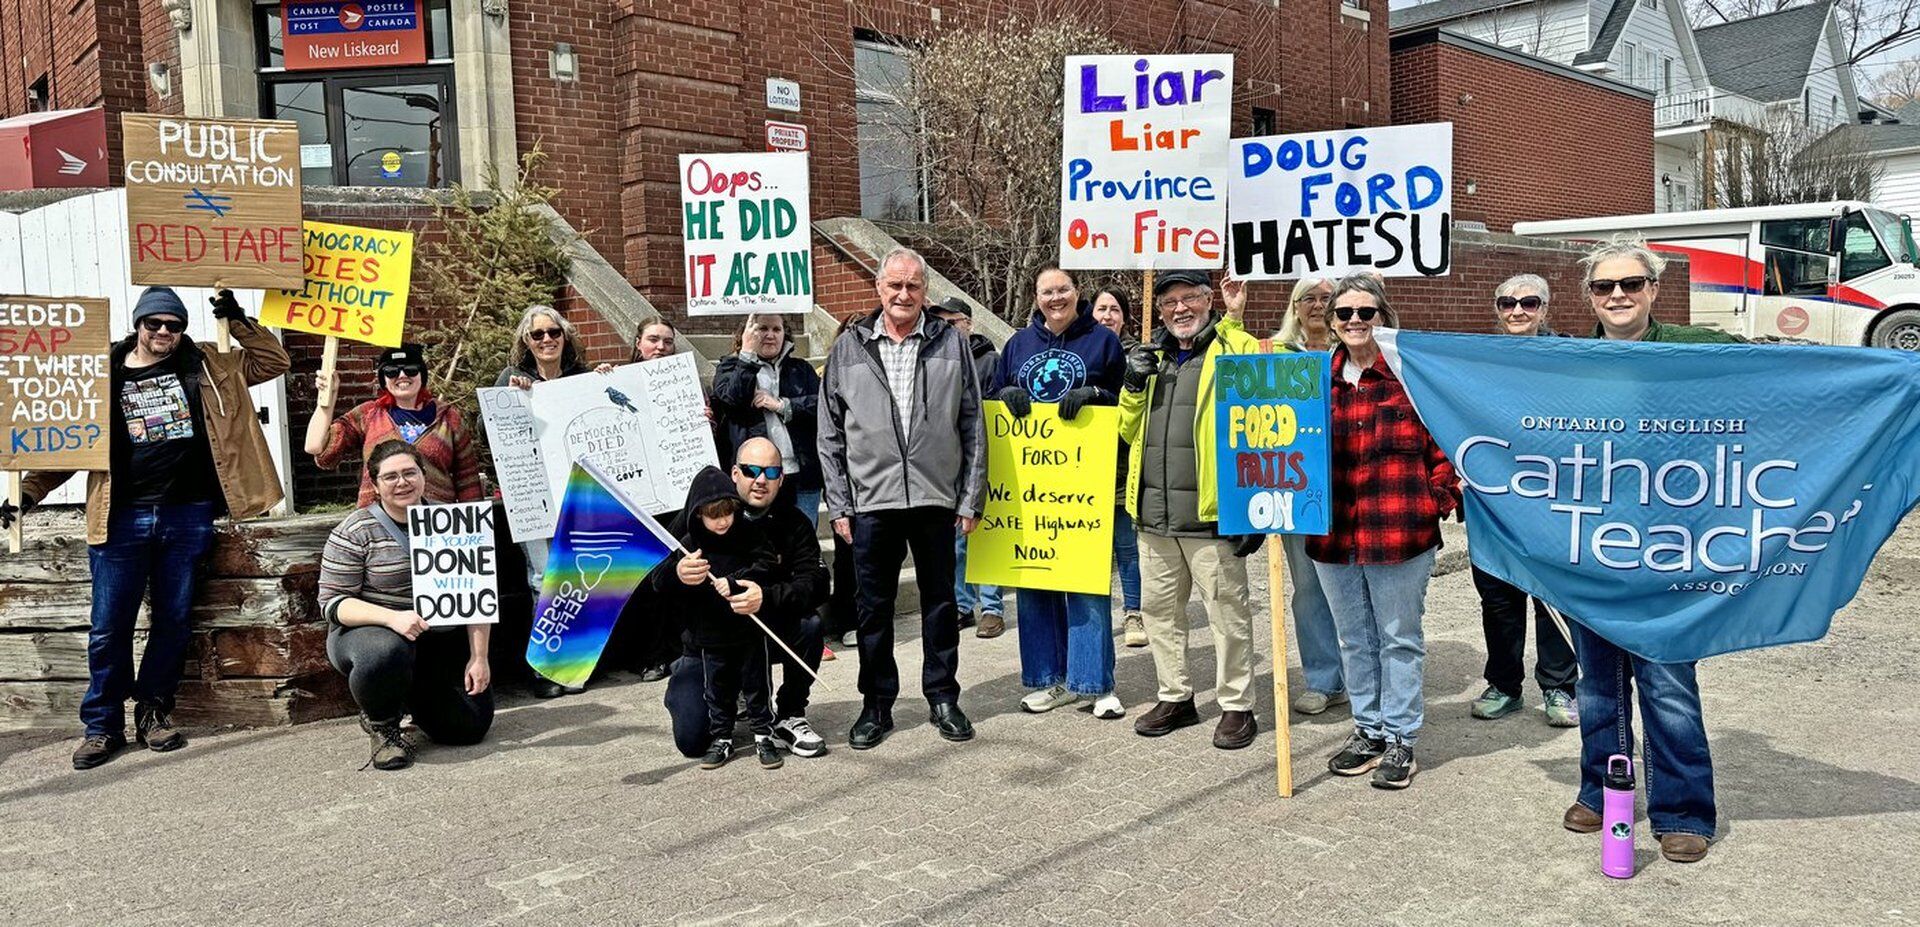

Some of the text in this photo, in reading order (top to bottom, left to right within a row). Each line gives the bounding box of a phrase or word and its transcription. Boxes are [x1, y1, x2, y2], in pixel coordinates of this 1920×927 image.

[293, 6, 336, 16] CANADA
[367, 3, 405, 12] POSTES
[294, 22, 319, 30] POST
[368, 18, 411, 27] CANADA
[308, 39, 399, 59] New Liskeard
[776, 86, 790, 96] NO
[1080, 58, 1225, 114] Liar
[159, 119, 282, 164] PUBLIC
[1110, 119, 1201, 151] Liar
[1242, 136, 1369, 178] DOUG
[126, 160, 294, 188] CONSULTATION
[1068, 158, 1216, 201] Province
[1300, 165, 1443, 217] FORD
[685, 197, 797, 241] HE DID
[136, 223, 300, 264] RED TAPE
[1067, 209, 1220, 260] On Fire
[689, 249, 811, 298] IT AGAIN
[690, 299, 717, 307] Ontario
[741, 295, 757, 304] The
[286, 301, 375, 336] FOI'S
[33, 354, 109, 378] WHERE
[643, 355, 691, 376] Wasteful
[649, 374, 693, 392] Spending
[12, 399, 103, 422] ABOUT
[483, 389, 525, 410] FOI
[570, 421, 632, 445] DEMOCRACY
[994, 413, 1054, 439] DOUG
[1521, 415, 1746, 434] ONTARIO ENGLISH
[10, 423, 101, 454] KIDS?
[588, 435, 625, 453] DIED
[616, 469, 643, 482] GOVT
[1455, 435, 1799, 509] Catholic
[987, 482, 1095, 506] We deserve
[410, 505, 494, 536] HONK
[982, 515, 1024, 530] SAFE
[1247, 491, 1295, 531] ON
[425, 537, 436, 547] IF
[413, 546, 495, 575] DONE
[433, 577, 474, 589] WITH
[415, 588, 498, 621] DOUG
